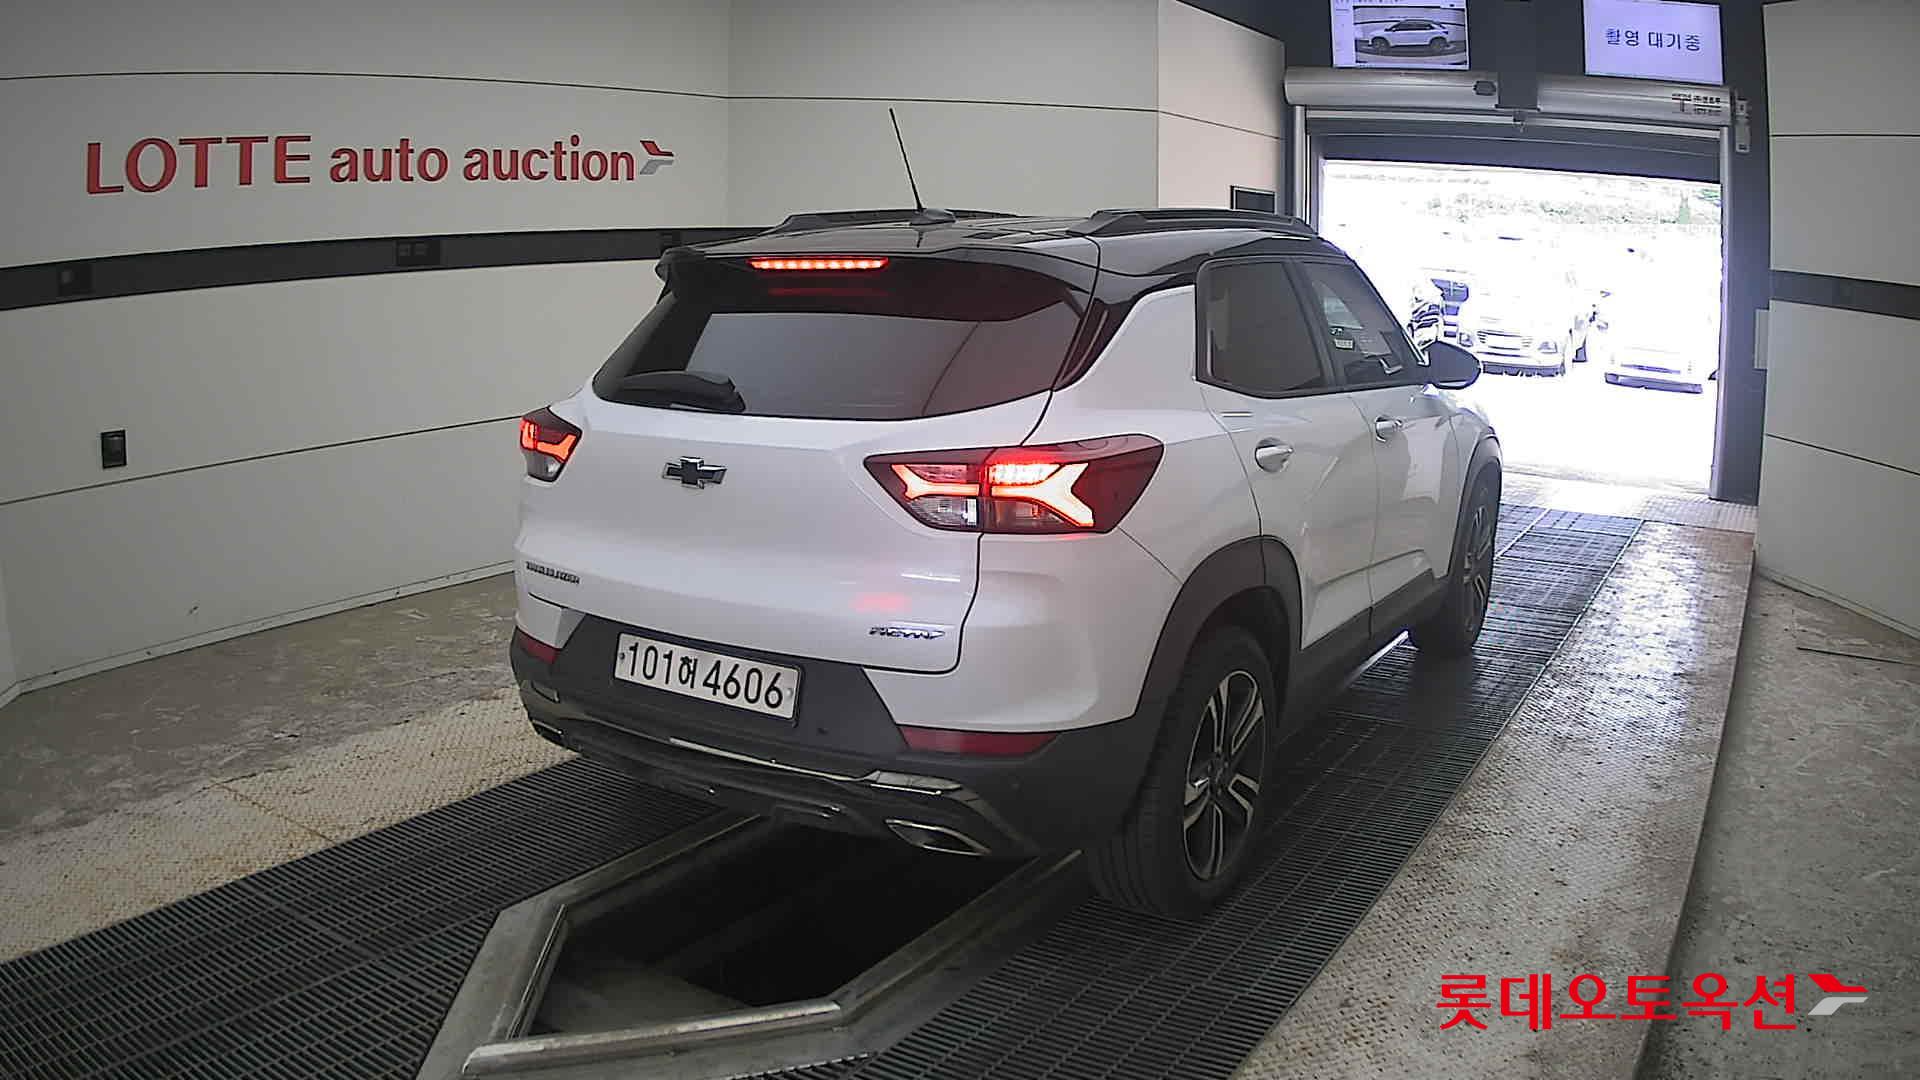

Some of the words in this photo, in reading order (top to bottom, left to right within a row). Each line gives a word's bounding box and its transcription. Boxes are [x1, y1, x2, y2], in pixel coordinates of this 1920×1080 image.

[1648, 31, 1701, 52] 대기중
[86, 135, 311, 194] LOTTE
[329, 138, 450, 183] auto
[463, 133, 635, 182] auction
